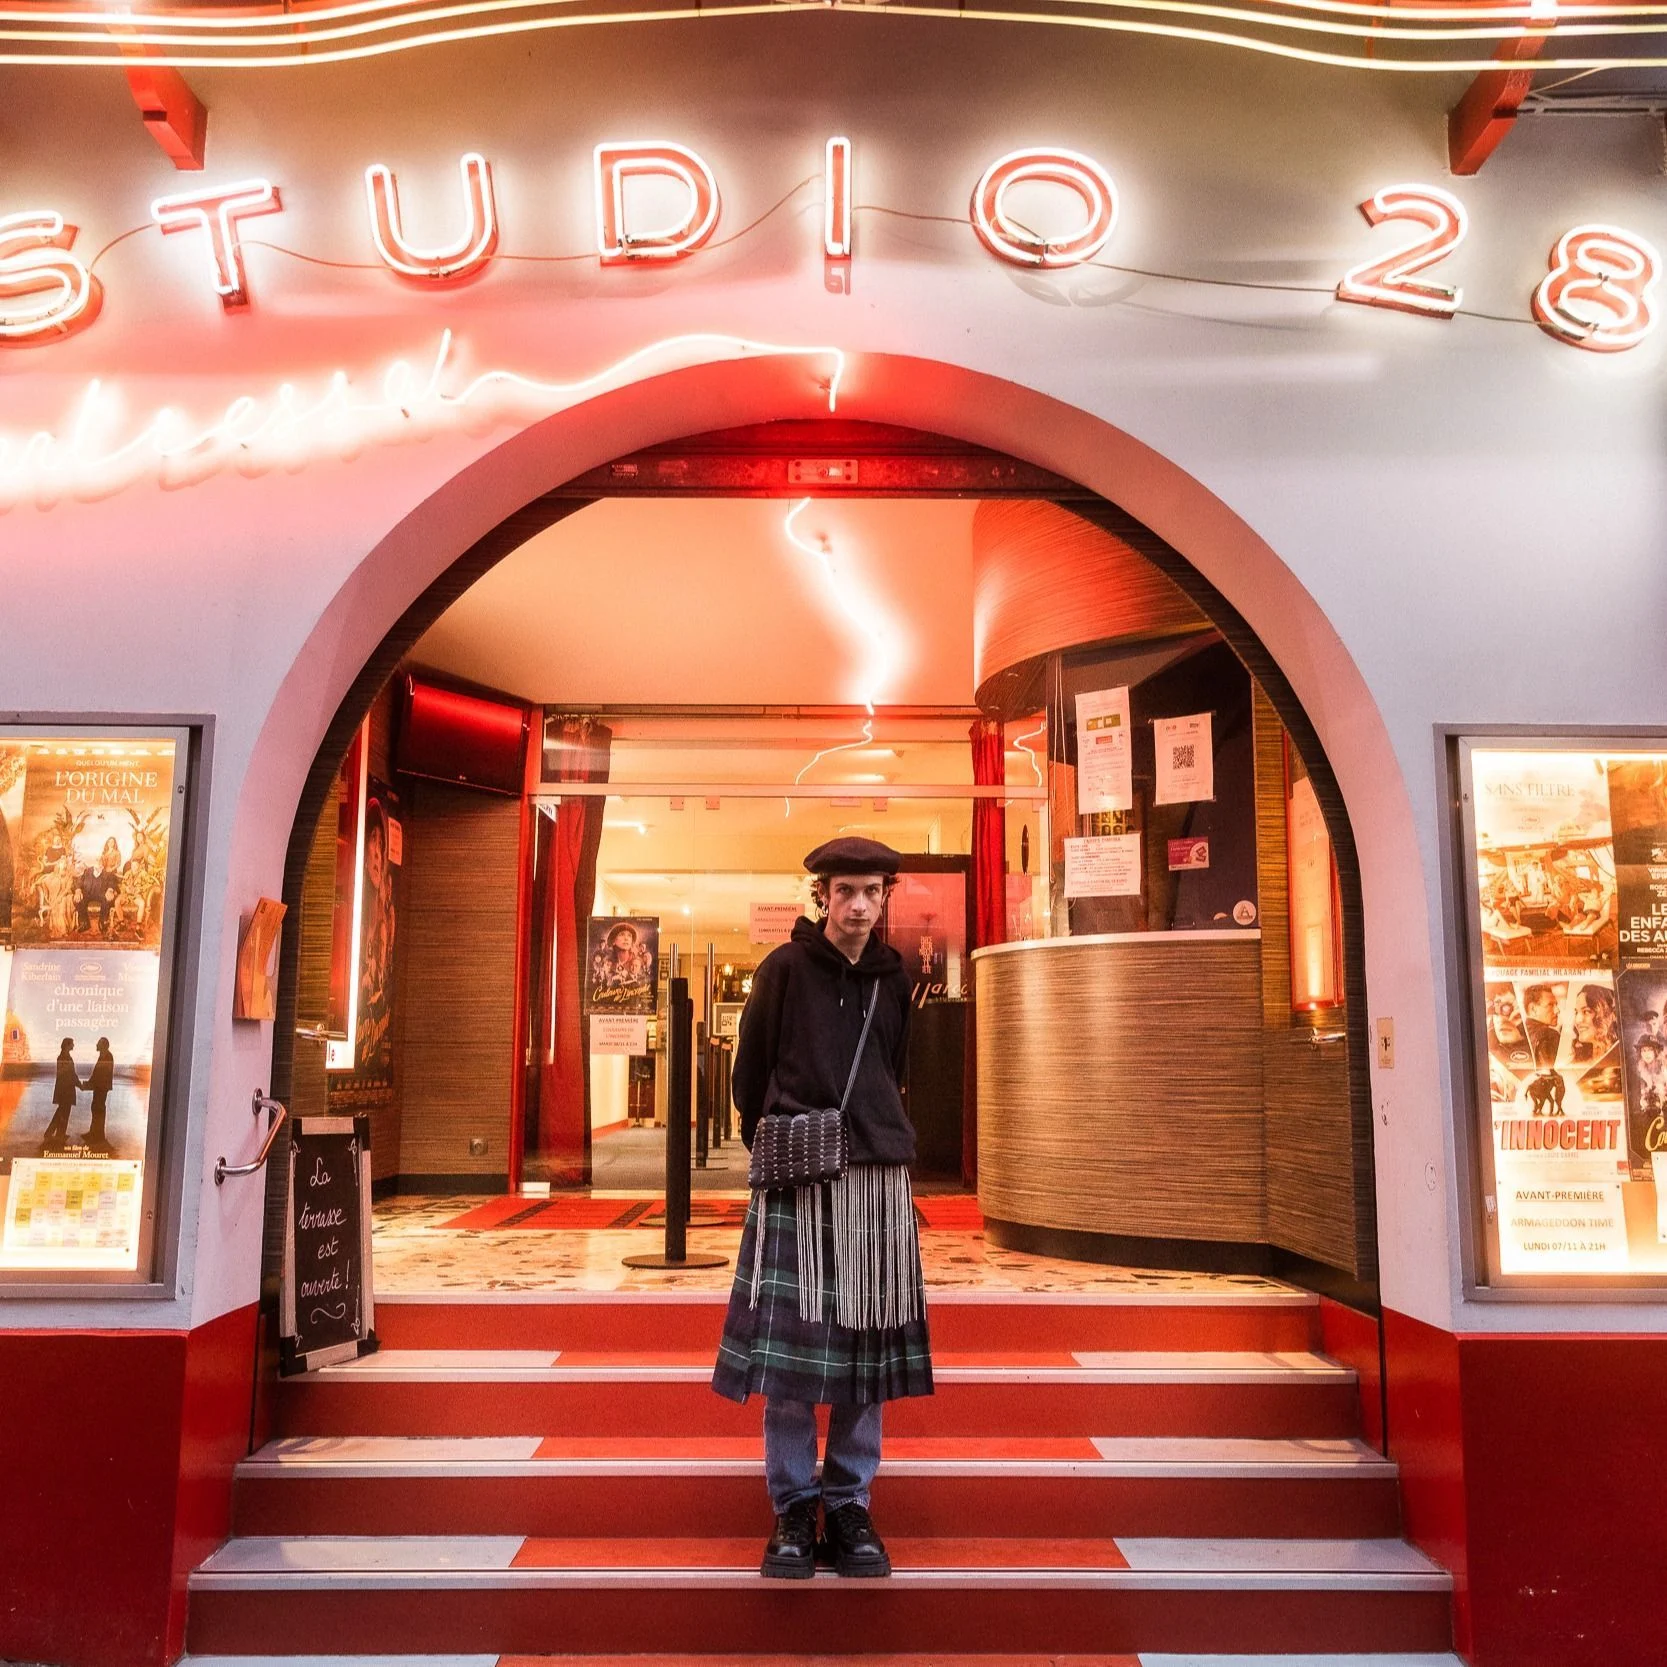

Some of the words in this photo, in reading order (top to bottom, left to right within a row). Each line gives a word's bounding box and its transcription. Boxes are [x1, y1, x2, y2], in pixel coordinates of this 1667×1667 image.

[0, 136, 1120, 349] STUDIO
[1335, 182, 1663, 354] 28
[54, 770, 159, 788] L'ORIGINE
[66, 788, 95, 804] DU
[99, 788, 145, 805] MAL
[1619, 929, 1651, 943] DES
[54, 983, 125, 998] chronique
[46, 1000, 84, 1013] d'une
[86, 1000, 129, 1013] liaison
[55, 1015, 119, 1031] passagère
[43, 1150, 82, 1159] Emmanuel
[82, 1151, 109, 1159] Mouret
[310, 1156, 332, 1187] La
[1515, 1190, 1604, 1200] AVANT-PREMIÈRE
[298, 1201, 347, 1230] terrasse
[1510, 1218, 1586, 1228] ARMAGEDDON
[1588, 1218, 1614, 1228] TIME
[317, 1235, 339, 1260] est
[1523, 1242, 1550, 1251] LUNDI
[1552, 1242, 1578, 1252] 07/11
[1588, 1242, 1606, 1251] 21H
